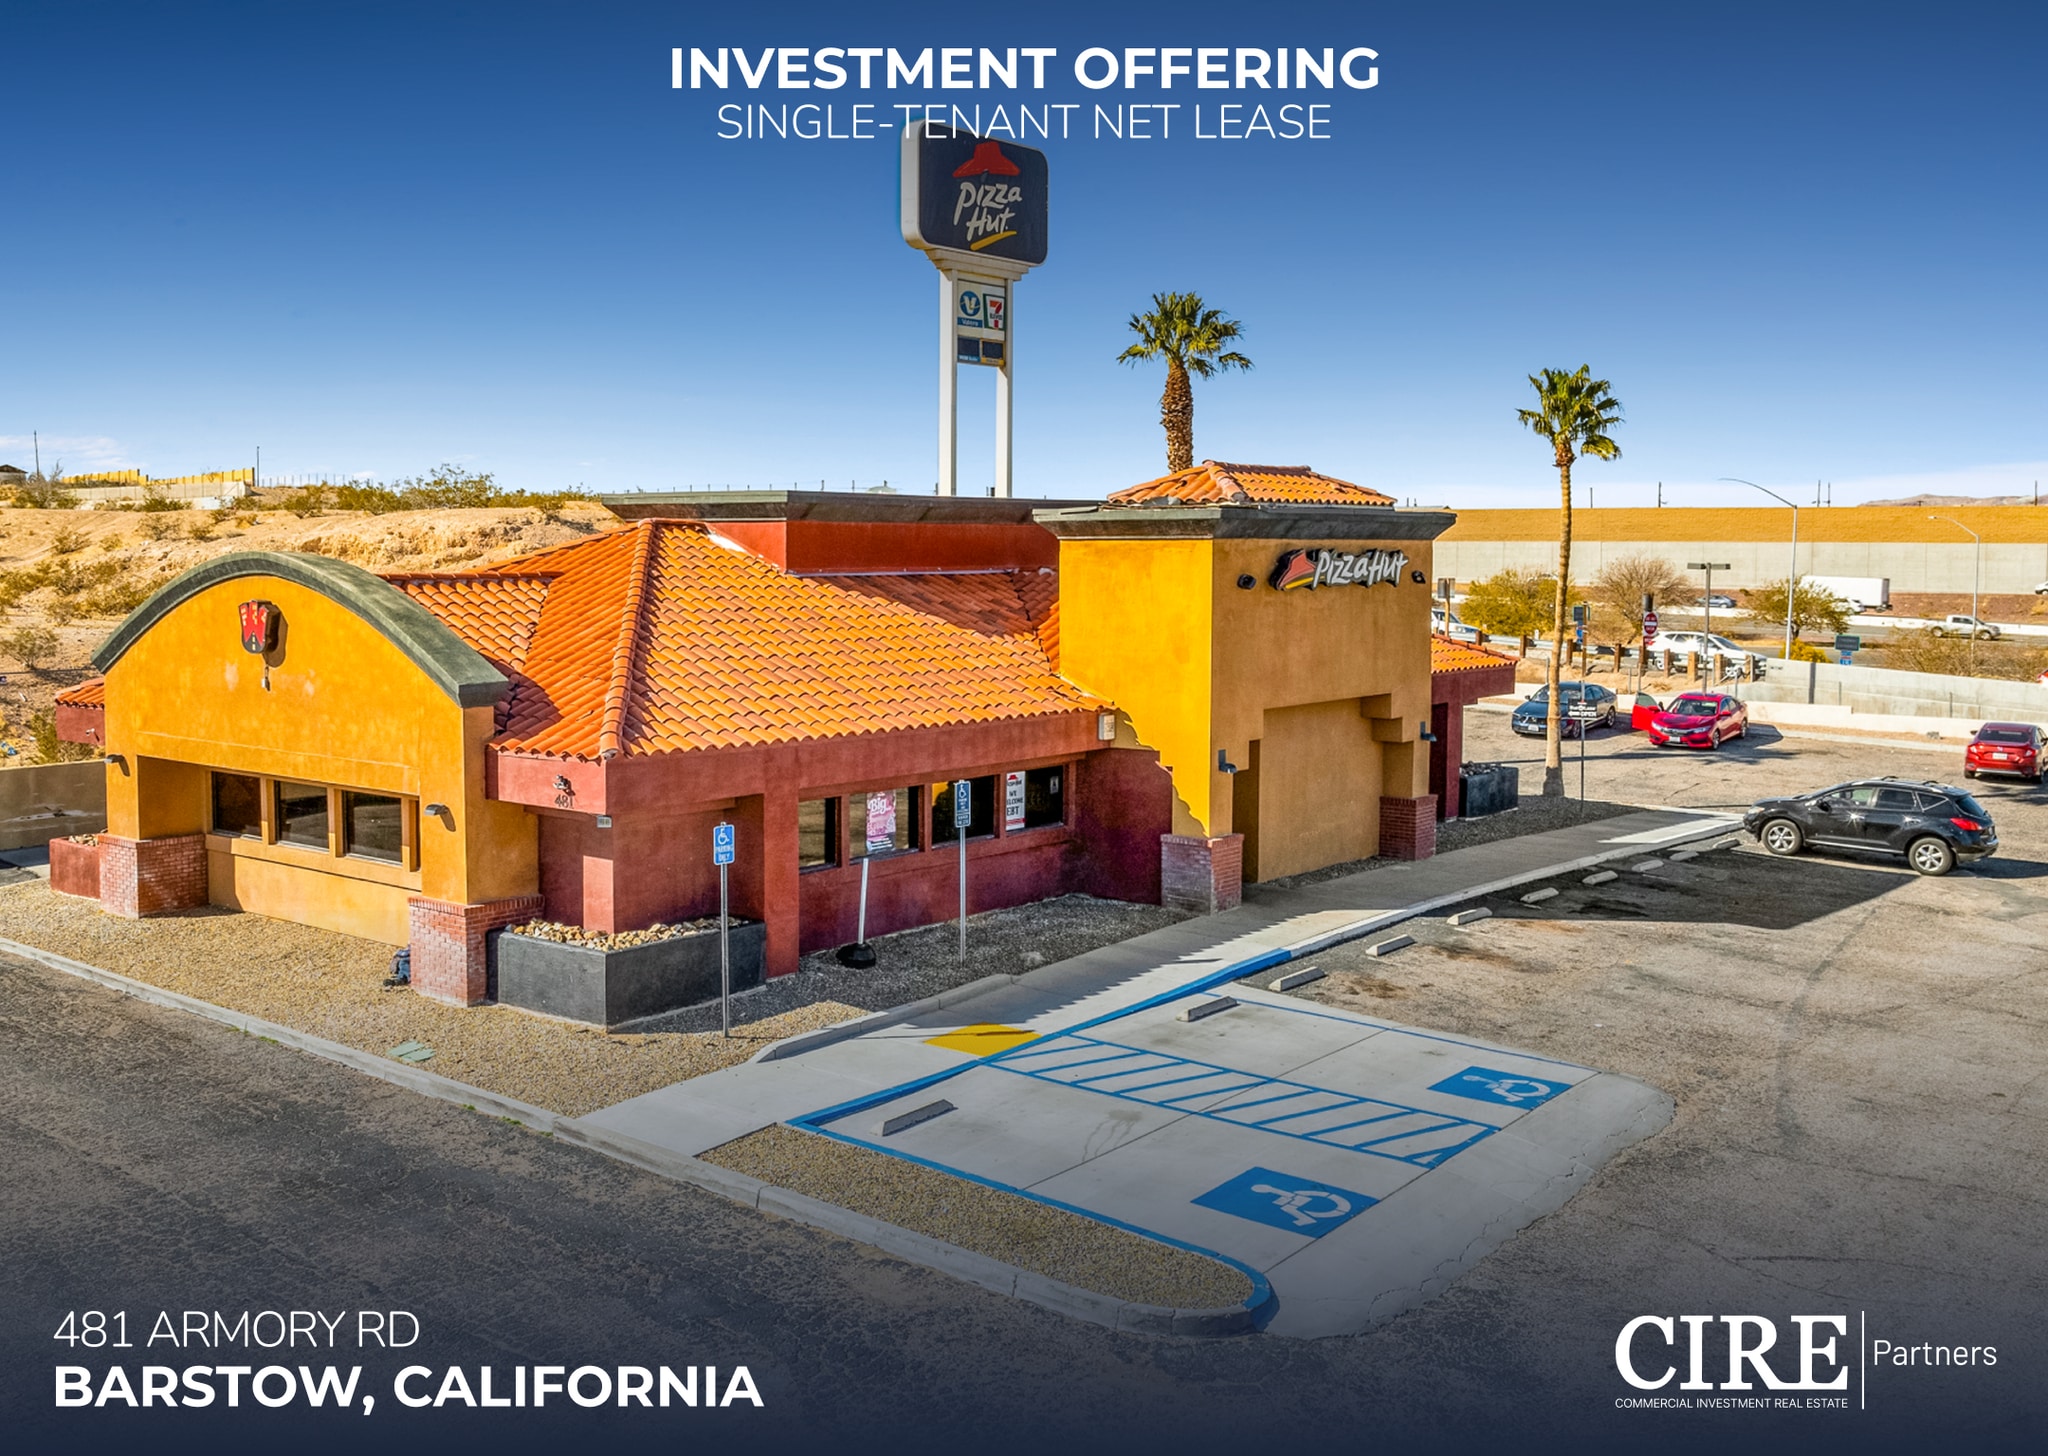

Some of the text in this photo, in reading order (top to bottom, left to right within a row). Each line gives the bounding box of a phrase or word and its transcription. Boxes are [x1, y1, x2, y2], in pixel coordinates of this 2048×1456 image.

[952, 181, 1023, 226] Pizza
[966, 207, 1016, 241] Hut
[1312, 549, 1409, 588] Pizza Hut
[554, 794, 574, 809] 481
[869, 797, 889, 814] Big
